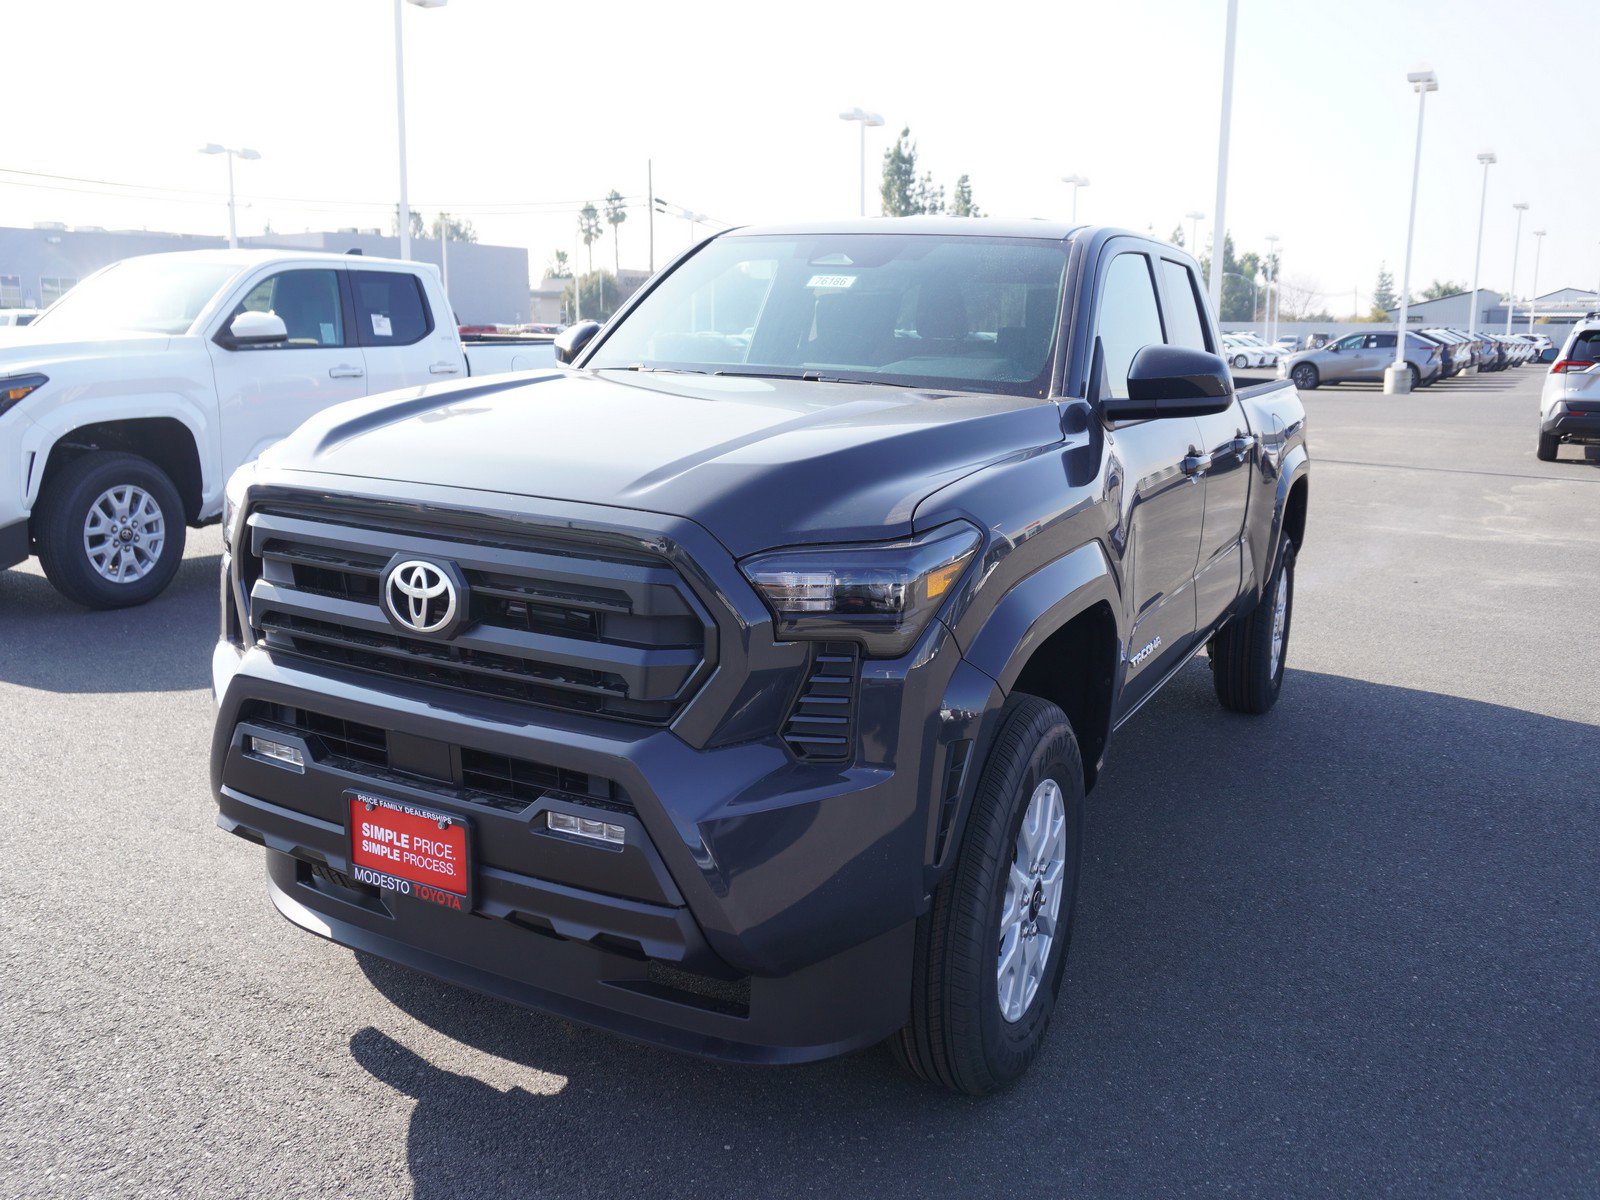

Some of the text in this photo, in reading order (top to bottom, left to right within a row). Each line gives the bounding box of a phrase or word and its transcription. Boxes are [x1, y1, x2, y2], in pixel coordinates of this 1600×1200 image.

[814, 276, 848, 286] 76186
[1130, 636, 1161, 667] TACOMA
[357, 794, 453, 825] PRICE FAMILY DEALERSHIPS
[361, 822, 456, 861] SIMPLE PRICE.
[361, 840, 457, 876] SIMPLE PROCESS.
[354, 867, 461, 911] MODESTO TOYOTA
